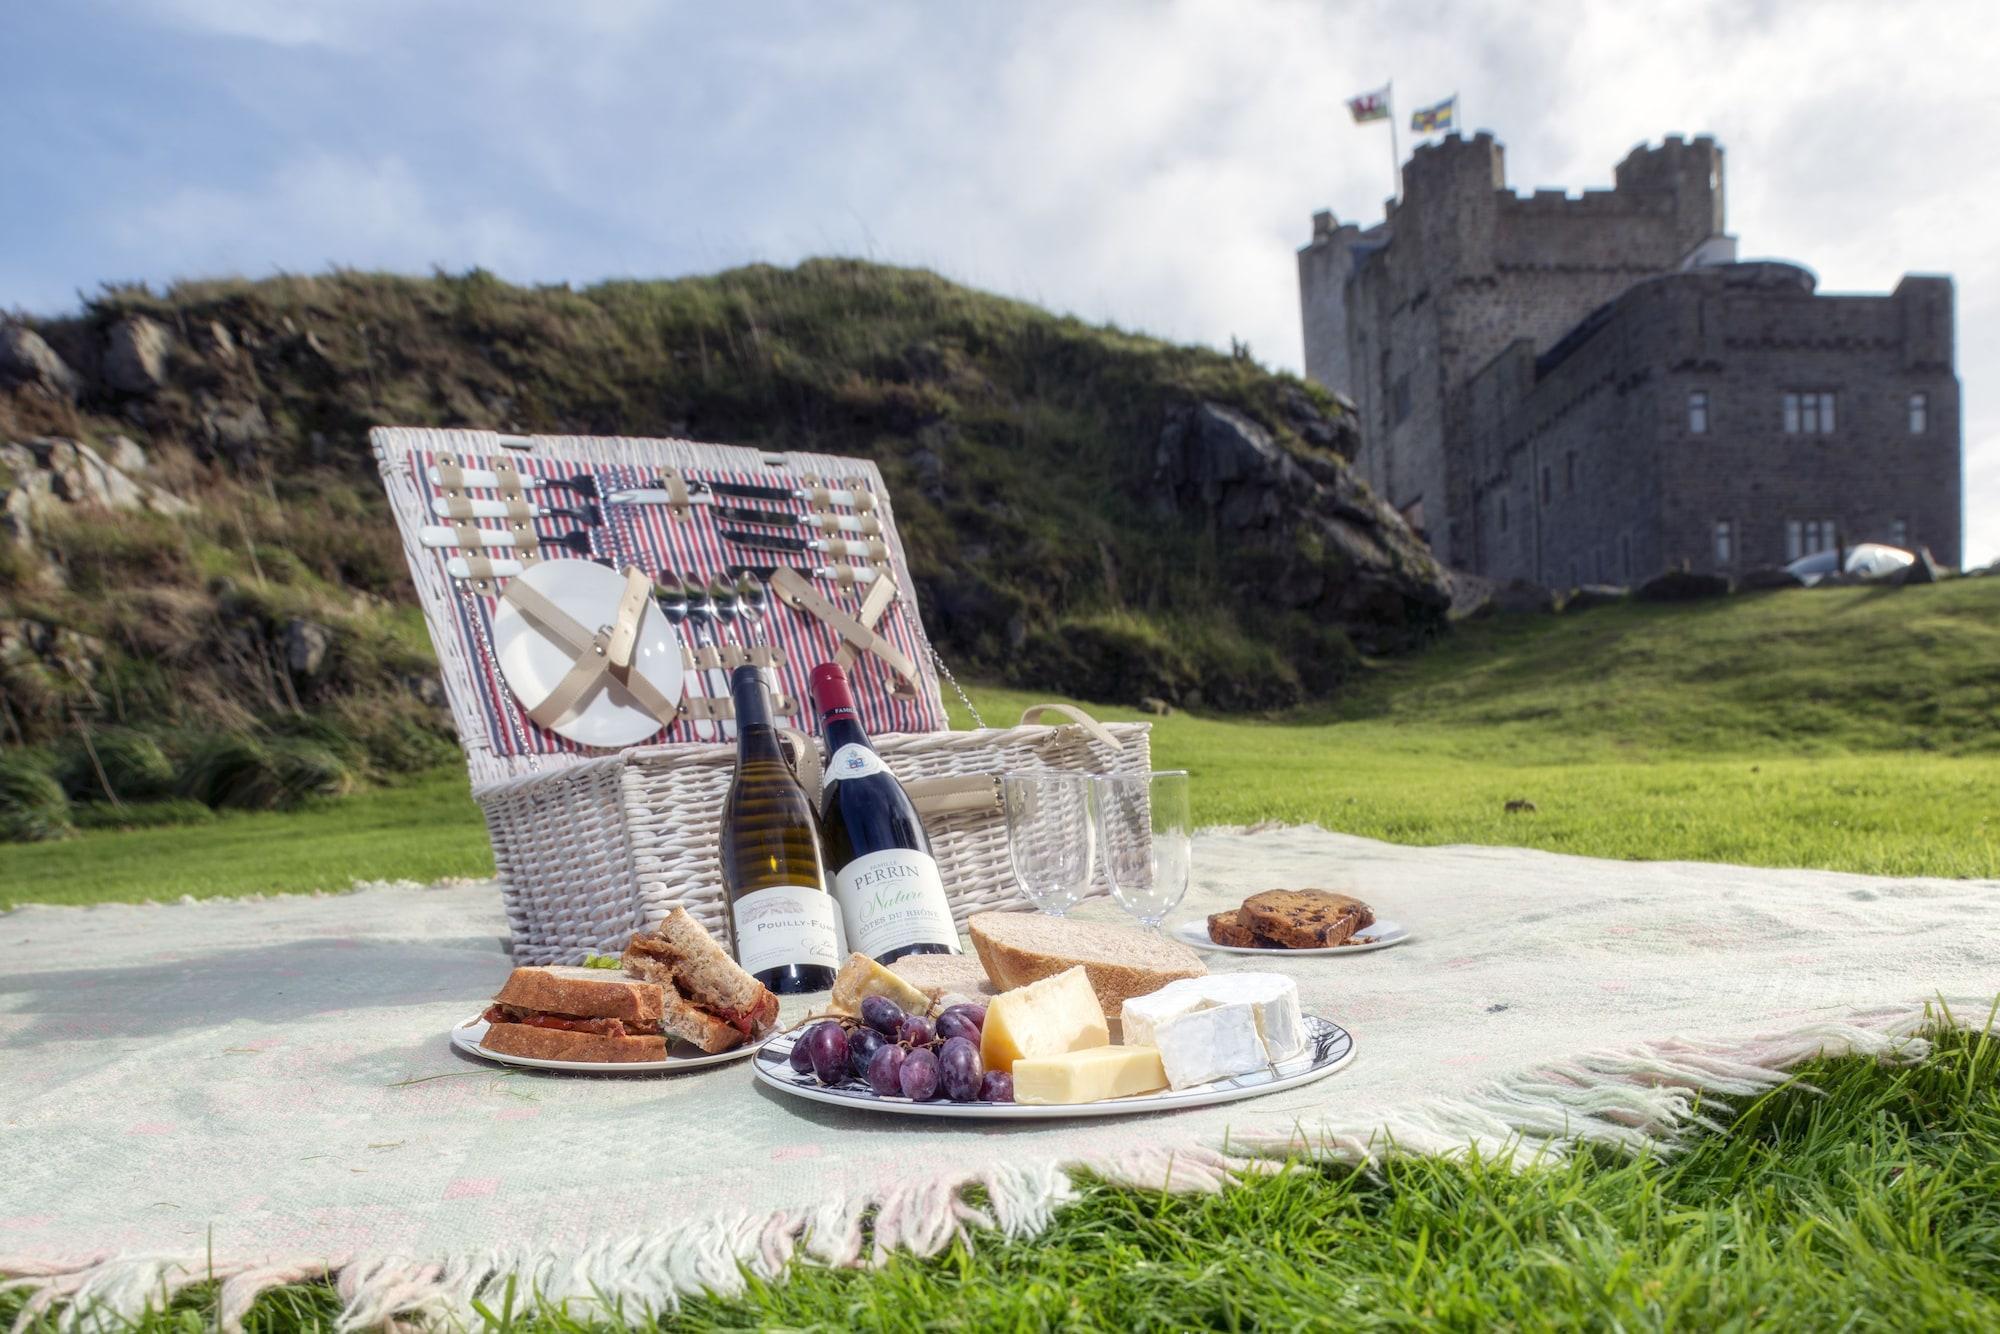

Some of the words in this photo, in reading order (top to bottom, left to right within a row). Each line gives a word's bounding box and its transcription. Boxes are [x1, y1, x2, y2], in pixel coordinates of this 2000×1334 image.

[854, 865, 921, 890] PERRIN
[860, 883, 924, 923] Nature
[888, 911, 903, 921] DU
